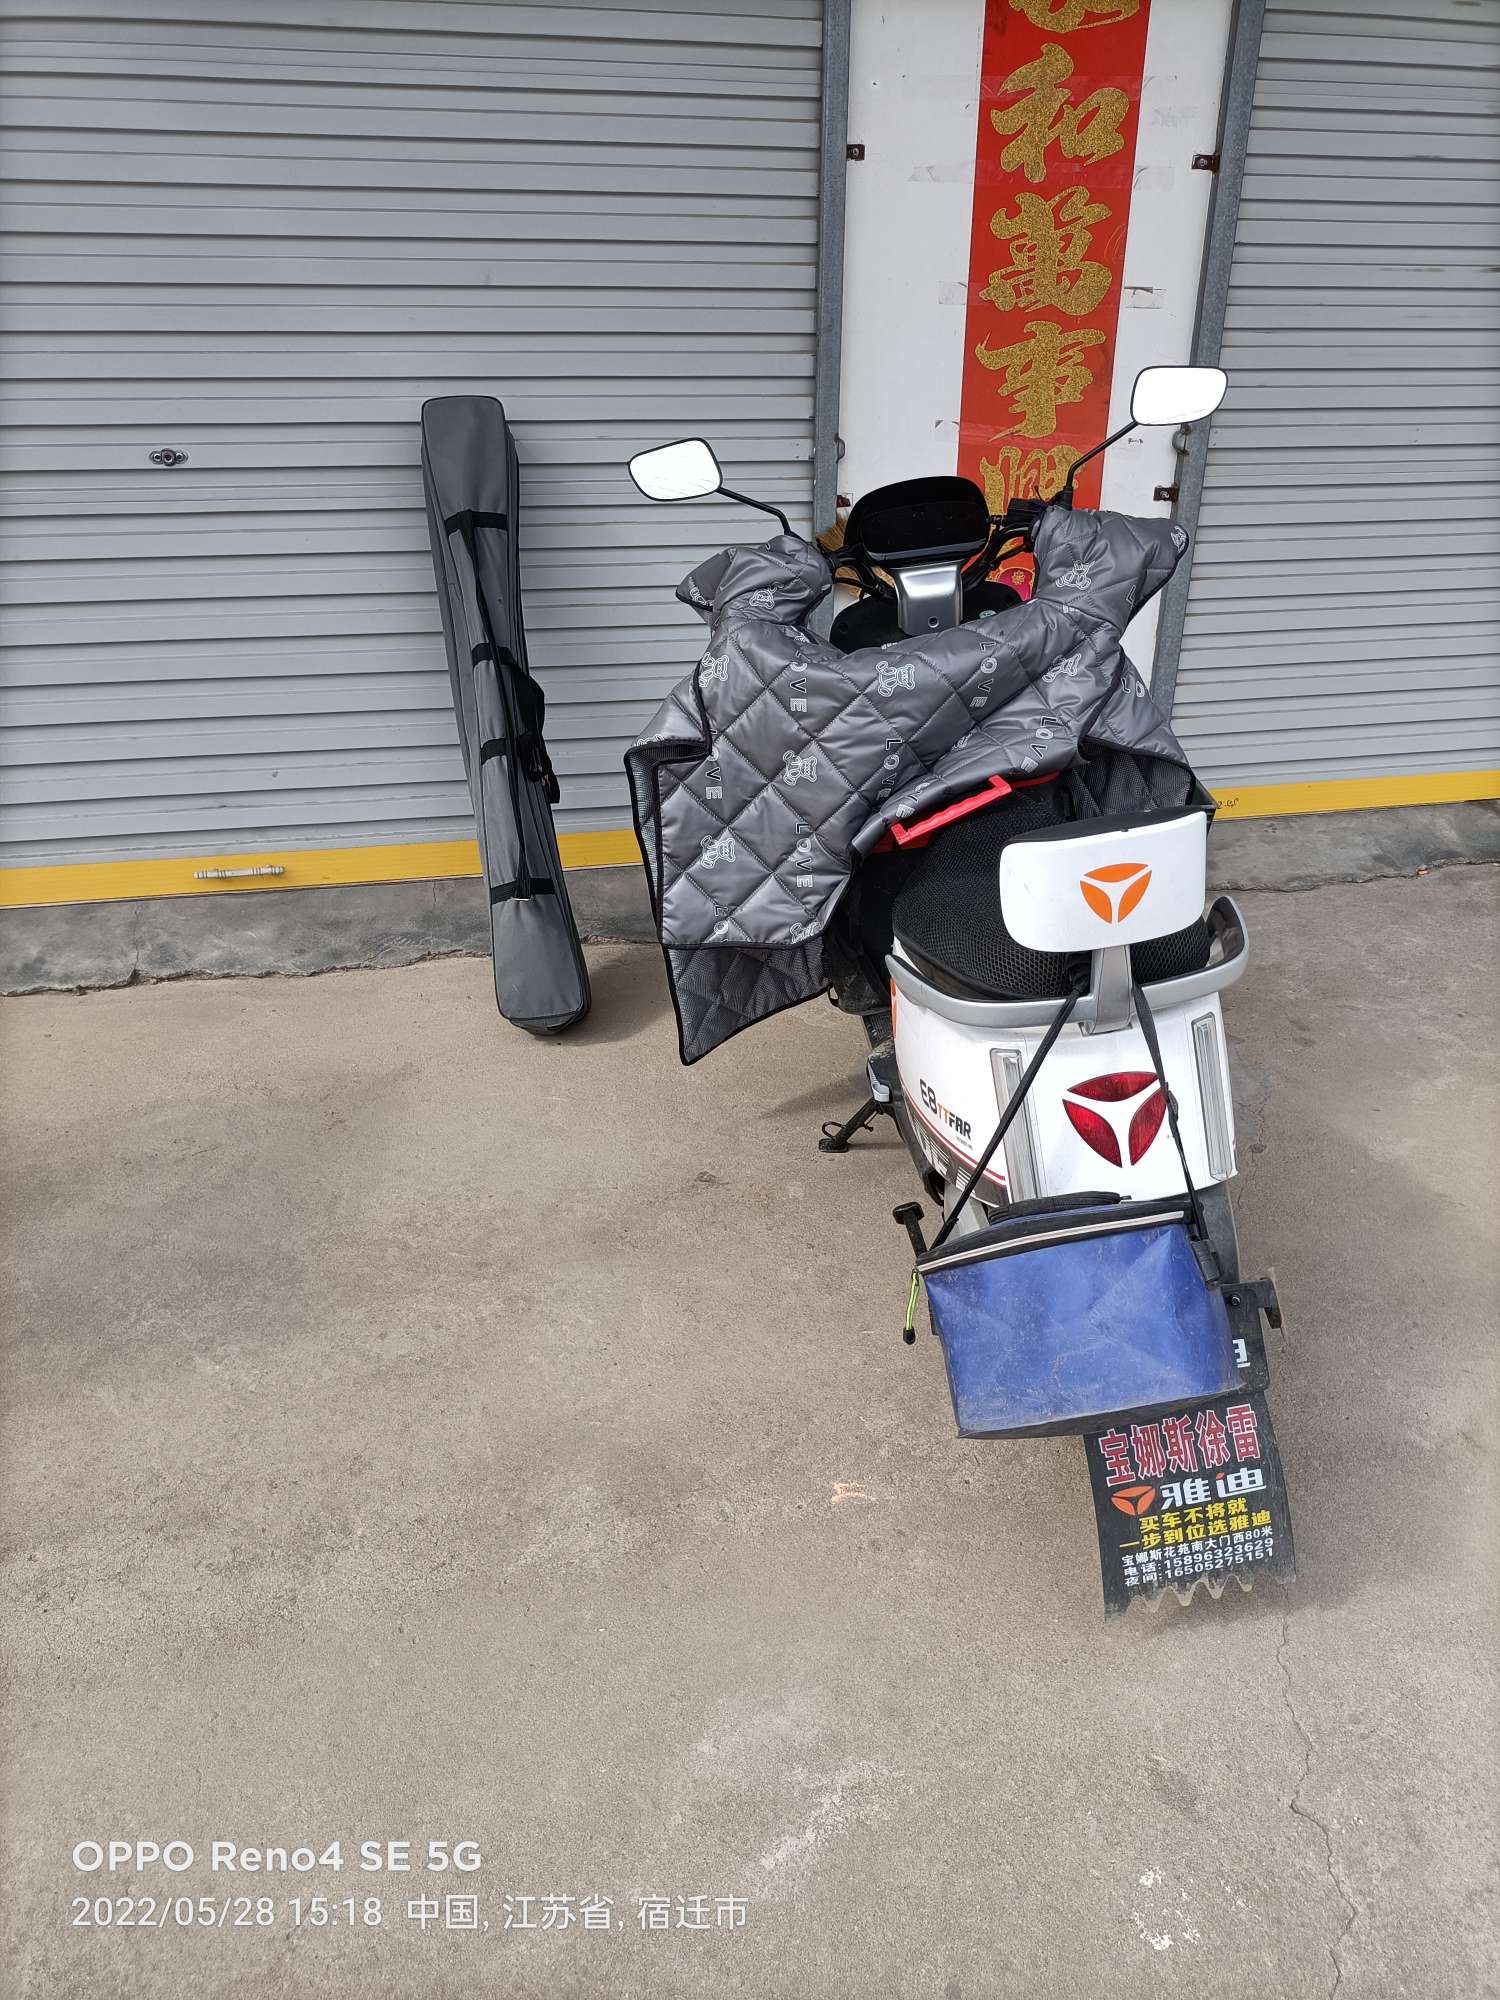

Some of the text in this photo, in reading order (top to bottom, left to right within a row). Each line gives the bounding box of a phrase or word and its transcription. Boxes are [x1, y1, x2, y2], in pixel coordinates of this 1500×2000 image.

[975, 0, 1139, 525] 和萬事
[969, 641, 997, 708] LOVE
[876, 738, 902, 801] LOVE
[1020, 716, 1057, 774] LOVE
[795, 822, 814, 888] LOVE
[1098, 1403, 1261, 1487] 宝娜斯徐雷
[1138, 1497, 1248, 1534] 买车不将就
[1159, 1467, 1267, 1510] 雅迪
[1119, 1509, 1272, 1551] 一步到位选雅迪
